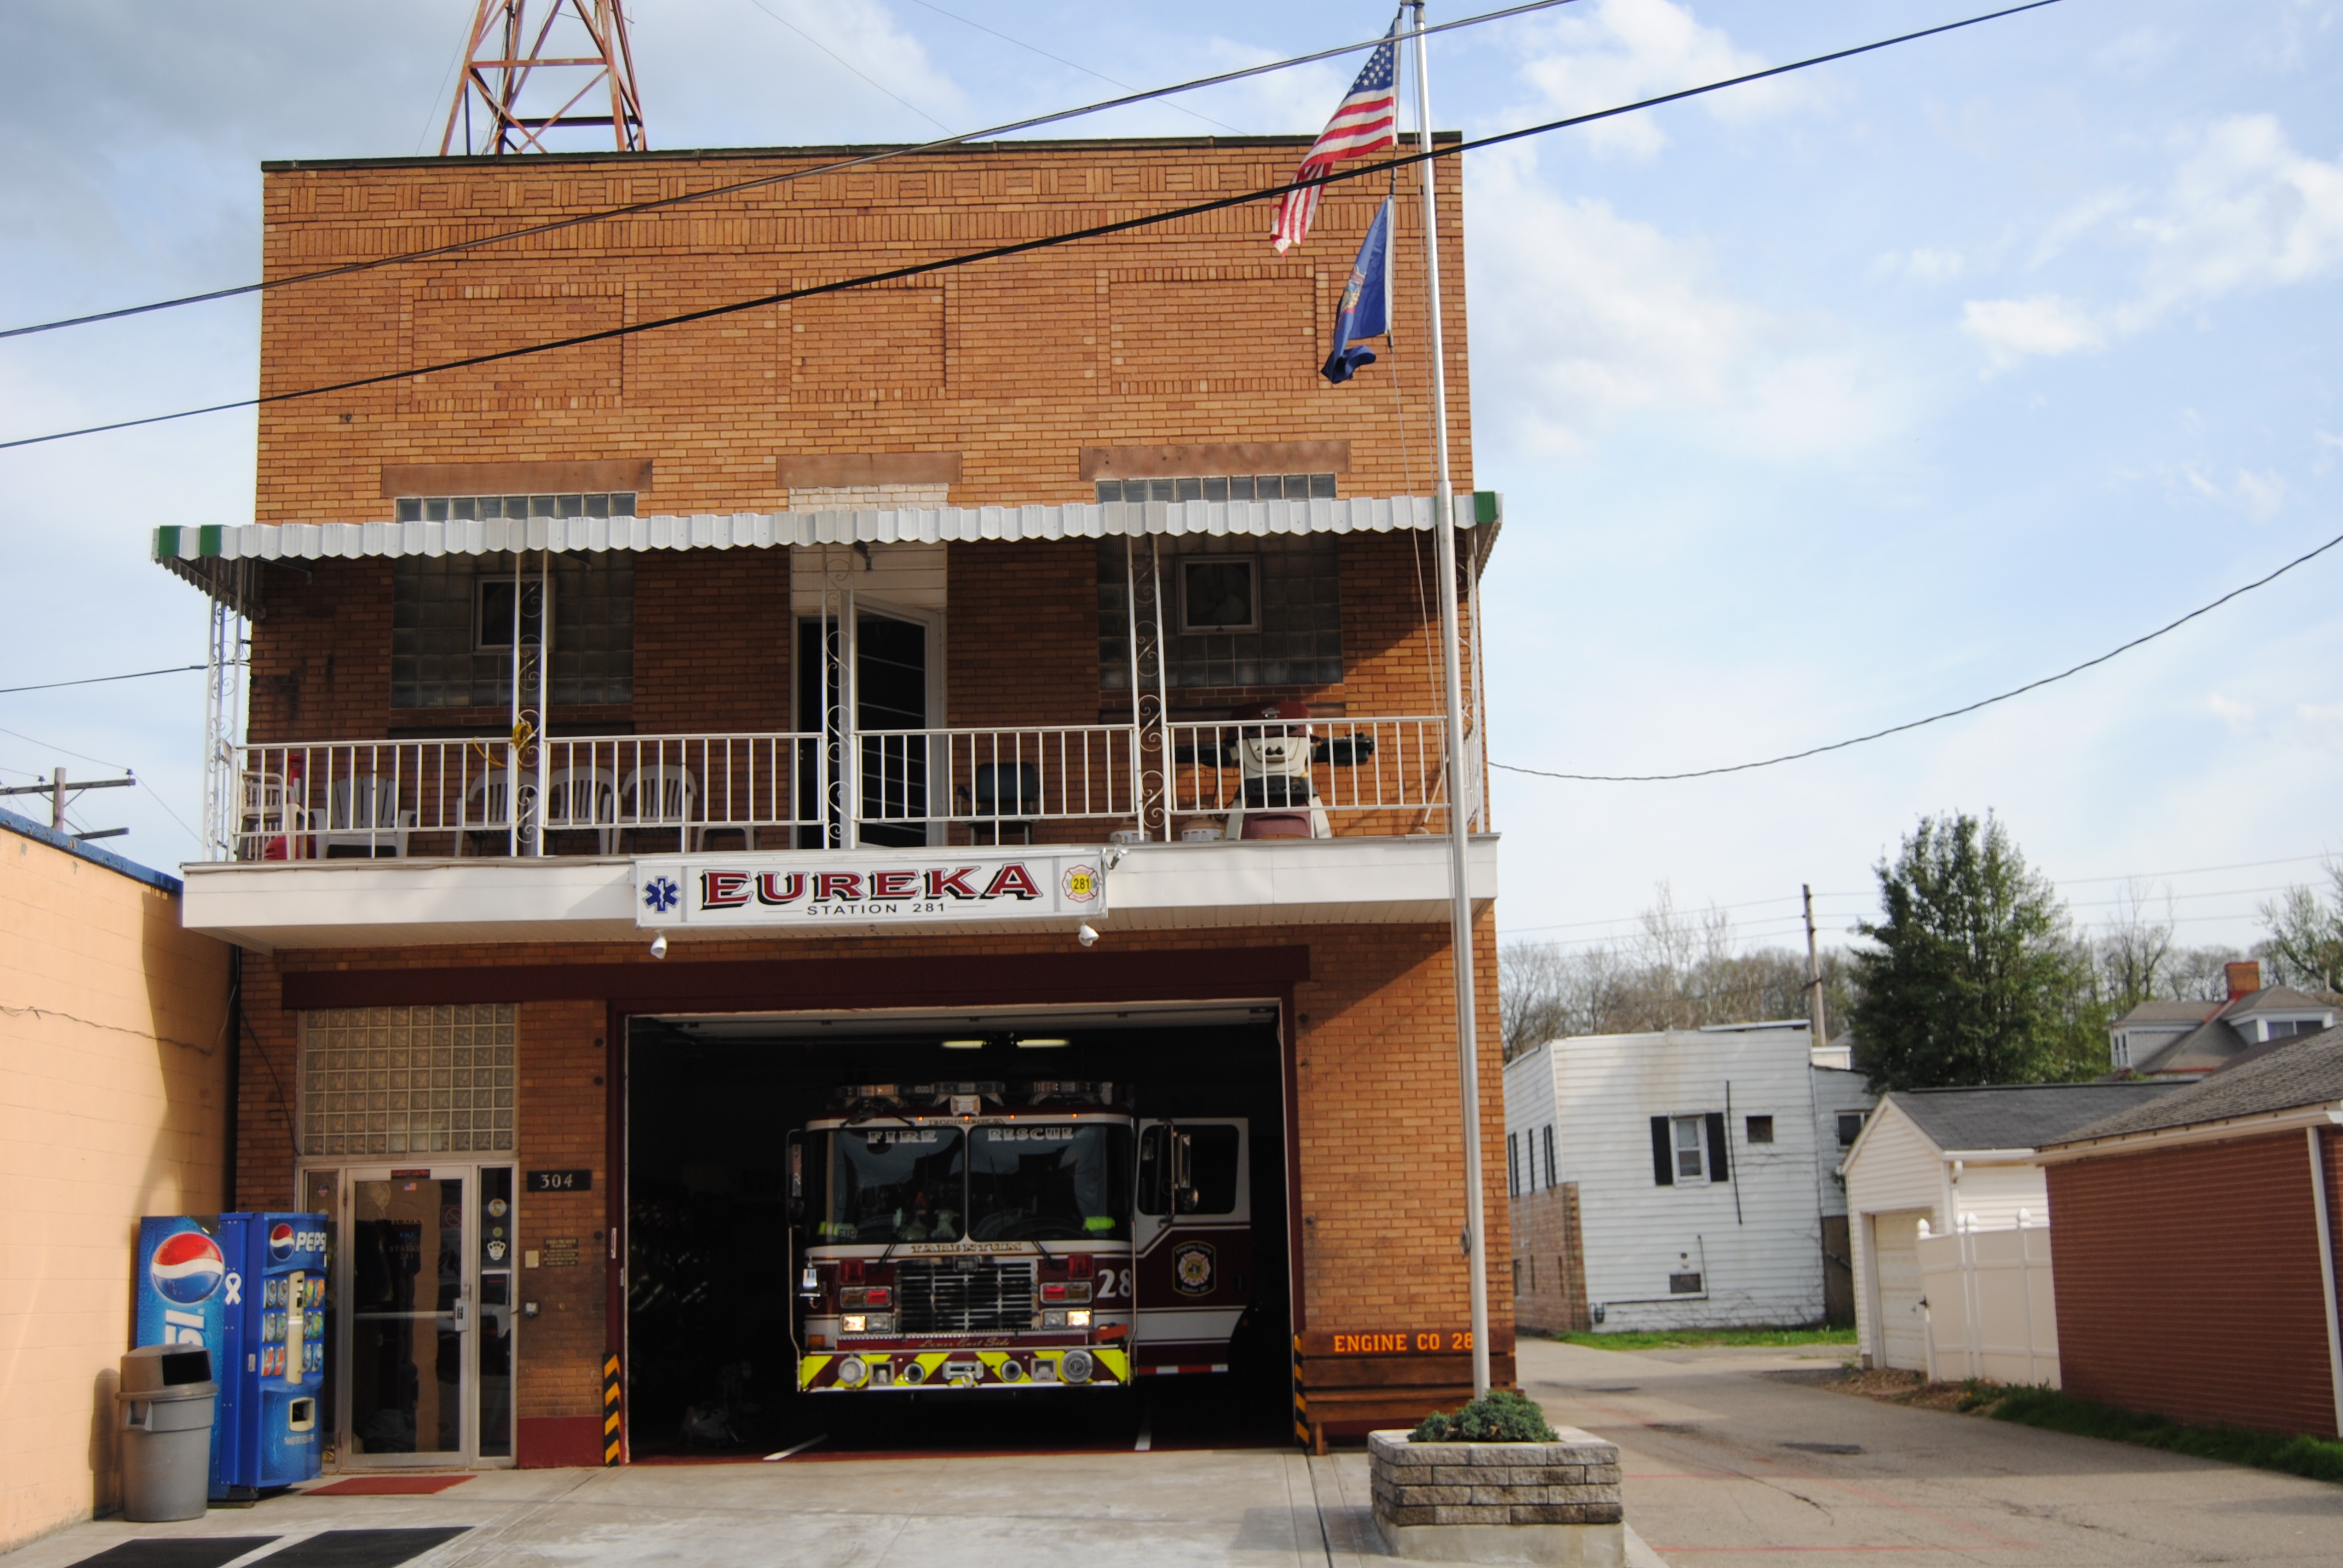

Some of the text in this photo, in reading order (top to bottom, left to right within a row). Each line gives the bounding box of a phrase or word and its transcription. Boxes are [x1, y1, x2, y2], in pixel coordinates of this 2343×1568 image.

[700, 861, 1044, 910] EUREKA
[1073, 877, 1090, 890] 281
[807, 902, 945, 915] STATION 281
[867, 1126, 1074, 1143] FIRE RESCUE
[540, 1173, 573, 1189] 304
[911, 1242, 1023, 1253] TARENTUM
[985, 1336, 1011, 1347] Side
[1334, 1333, 1407, 1353] ENGINE
[1417, 1333, 1440, 1351] CO
